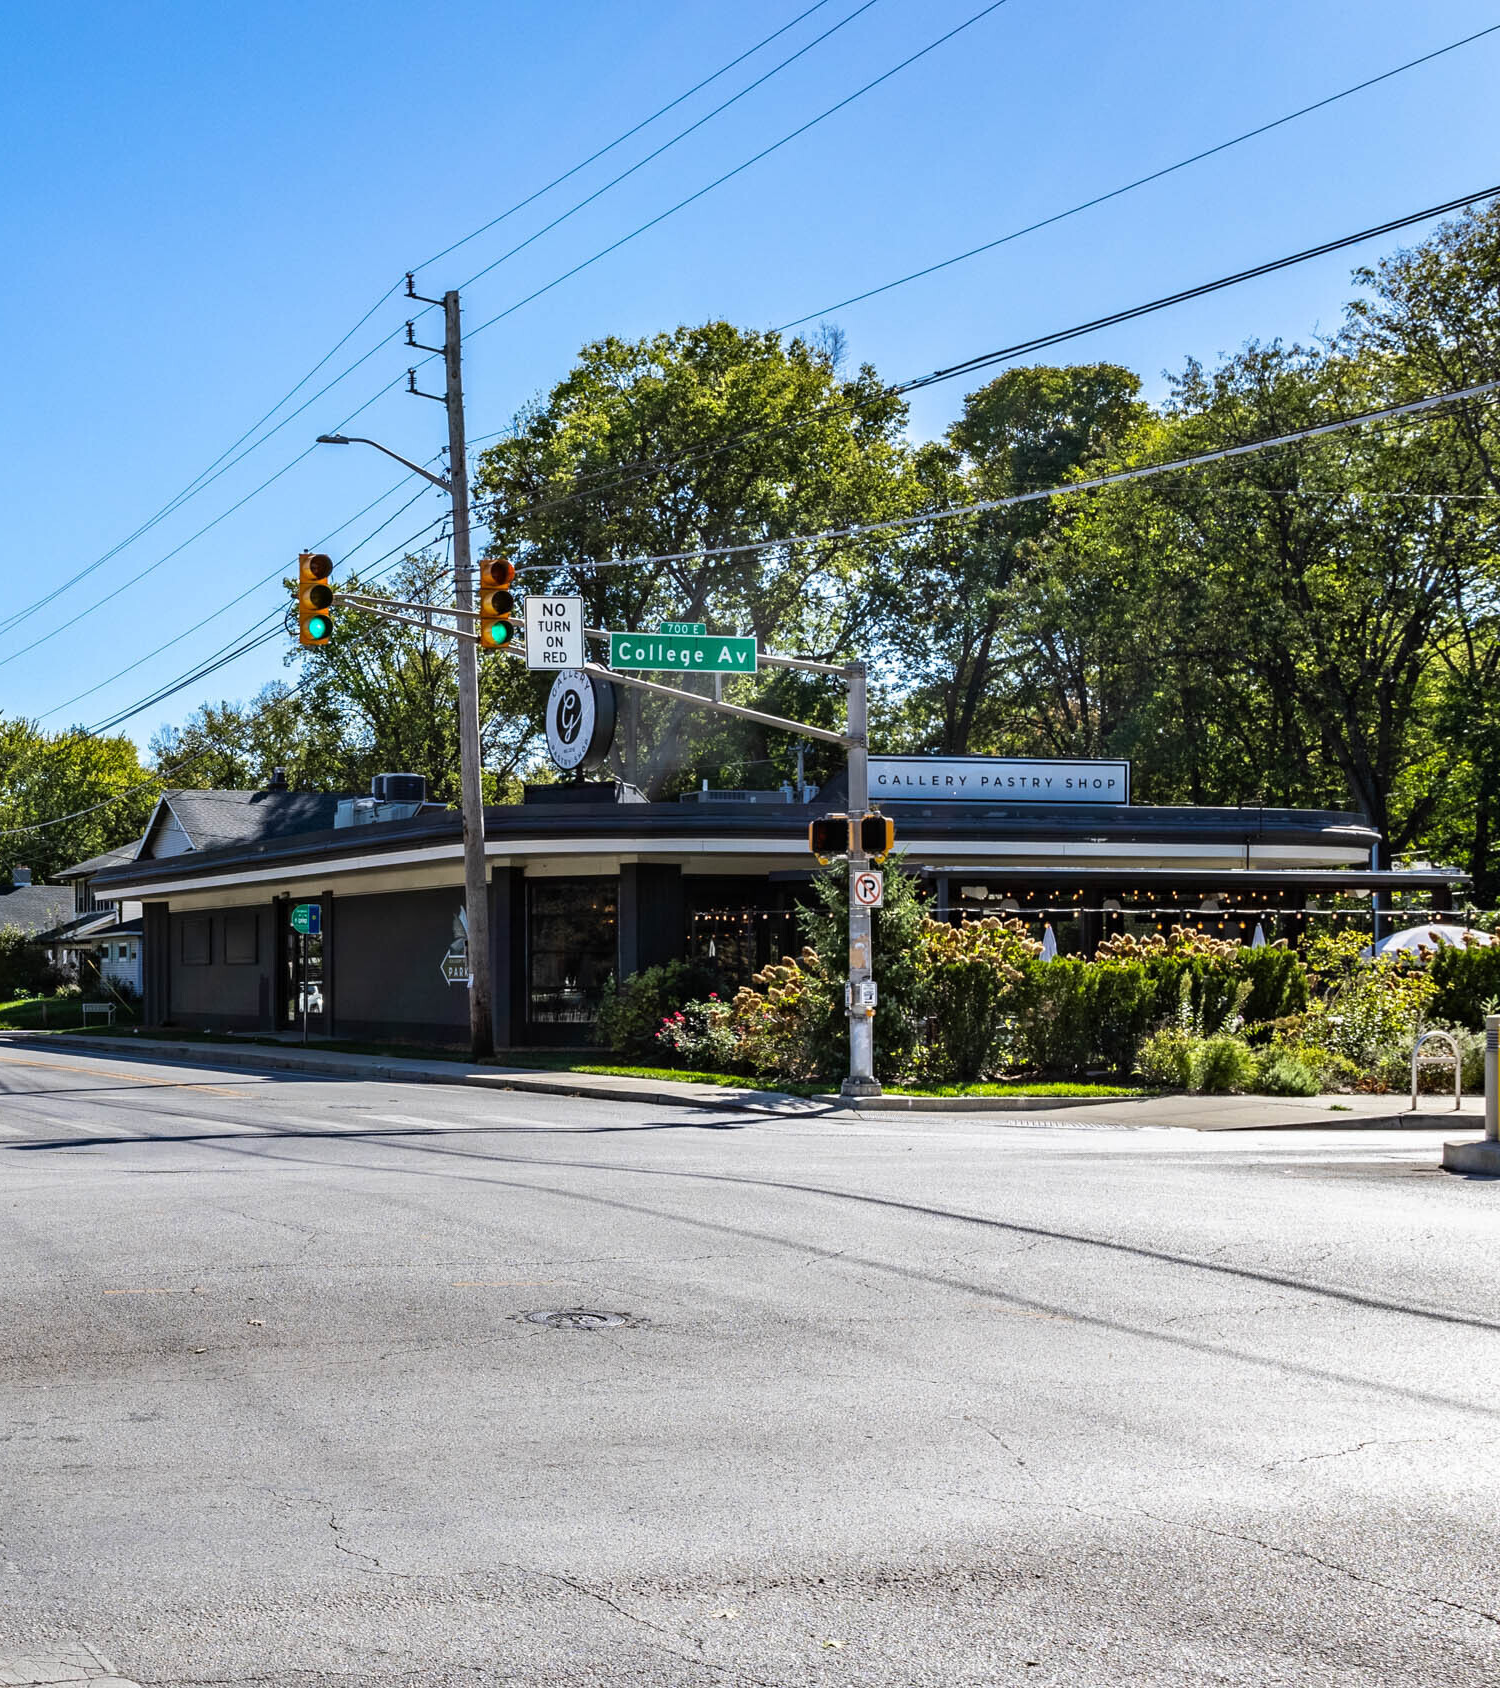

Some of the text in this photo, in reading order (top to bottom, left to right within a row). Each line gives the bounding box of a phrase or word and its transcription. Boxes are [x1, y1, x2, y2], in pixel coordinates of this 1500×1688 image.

[542, 603, 566, 617] NO
[538, 621, 571, 633] TURN
[667, 624, 700, 634] 700 E
[546, 636, 564, 648] ON
[543, 651, 568, 663] RED
[618, 642, 748, 667] College Av
[552, 671, 591, 698] GALLERY
[877, 774, 1116, 790] GALLERY PASTRY SHOP
